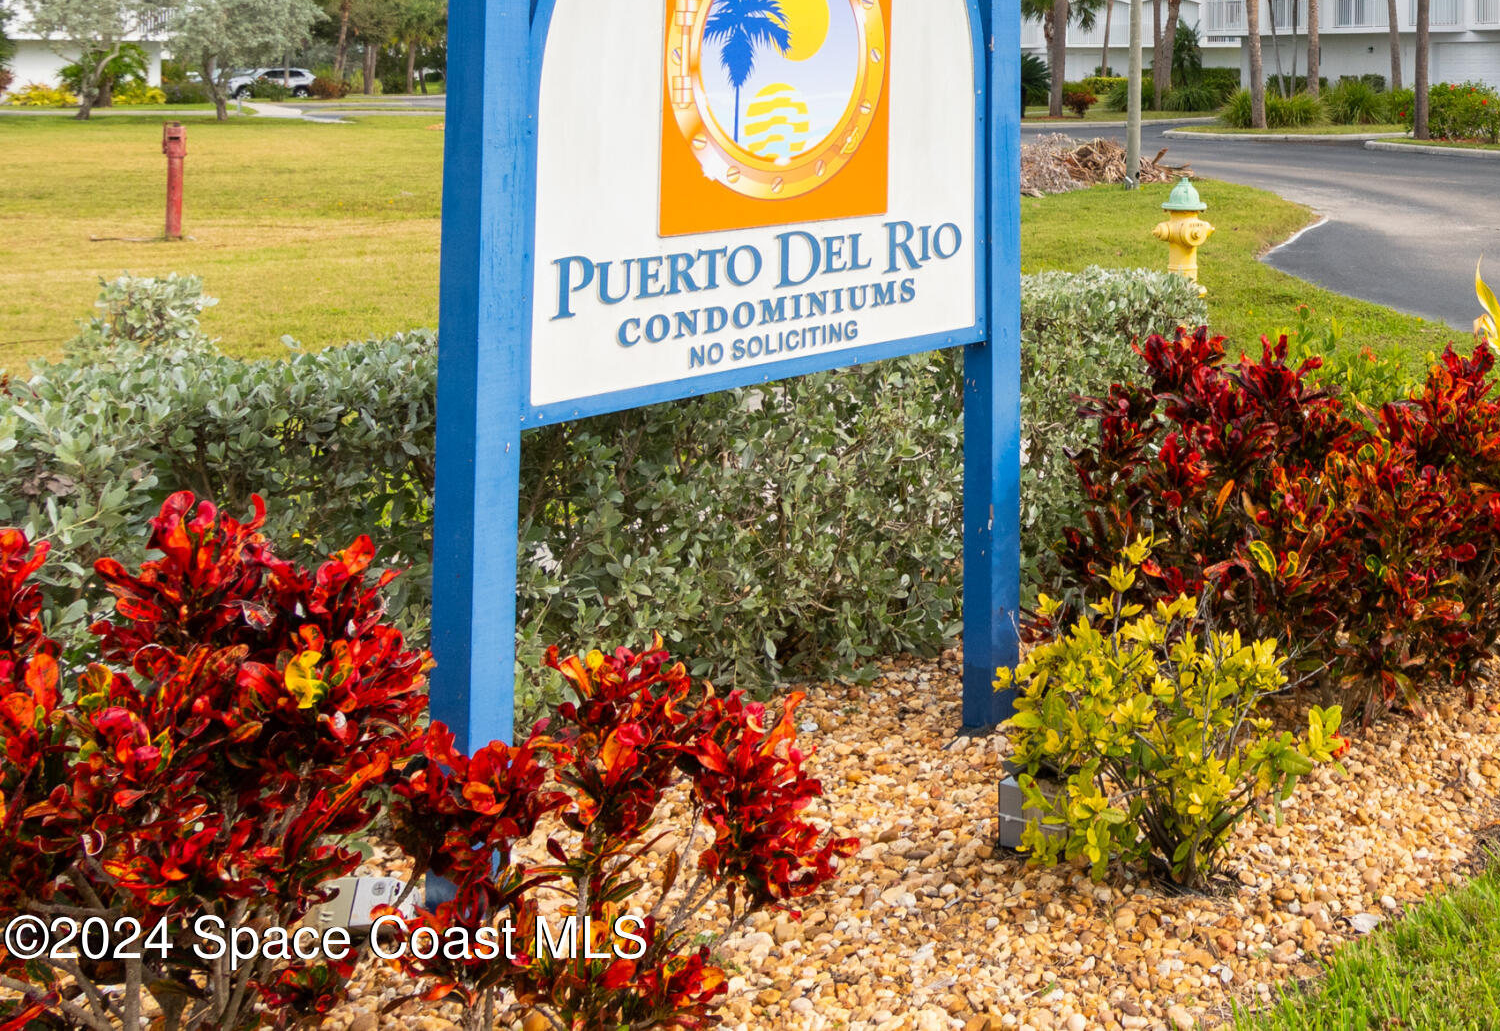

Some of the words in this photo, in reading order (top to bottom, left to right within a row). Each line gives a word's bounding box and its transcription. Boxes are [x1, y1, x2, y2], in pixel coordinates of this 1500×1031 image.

[551, 245, 763, 321] PUERTO
[774, 230, 872, 289] DEL
[882, 220, 963, 273] RIO
[617, 277, 916, 347] CONDOMINIUMS
[689, 342, 724, 368] NO
[732, 320, 859, 359] SOLICITING
